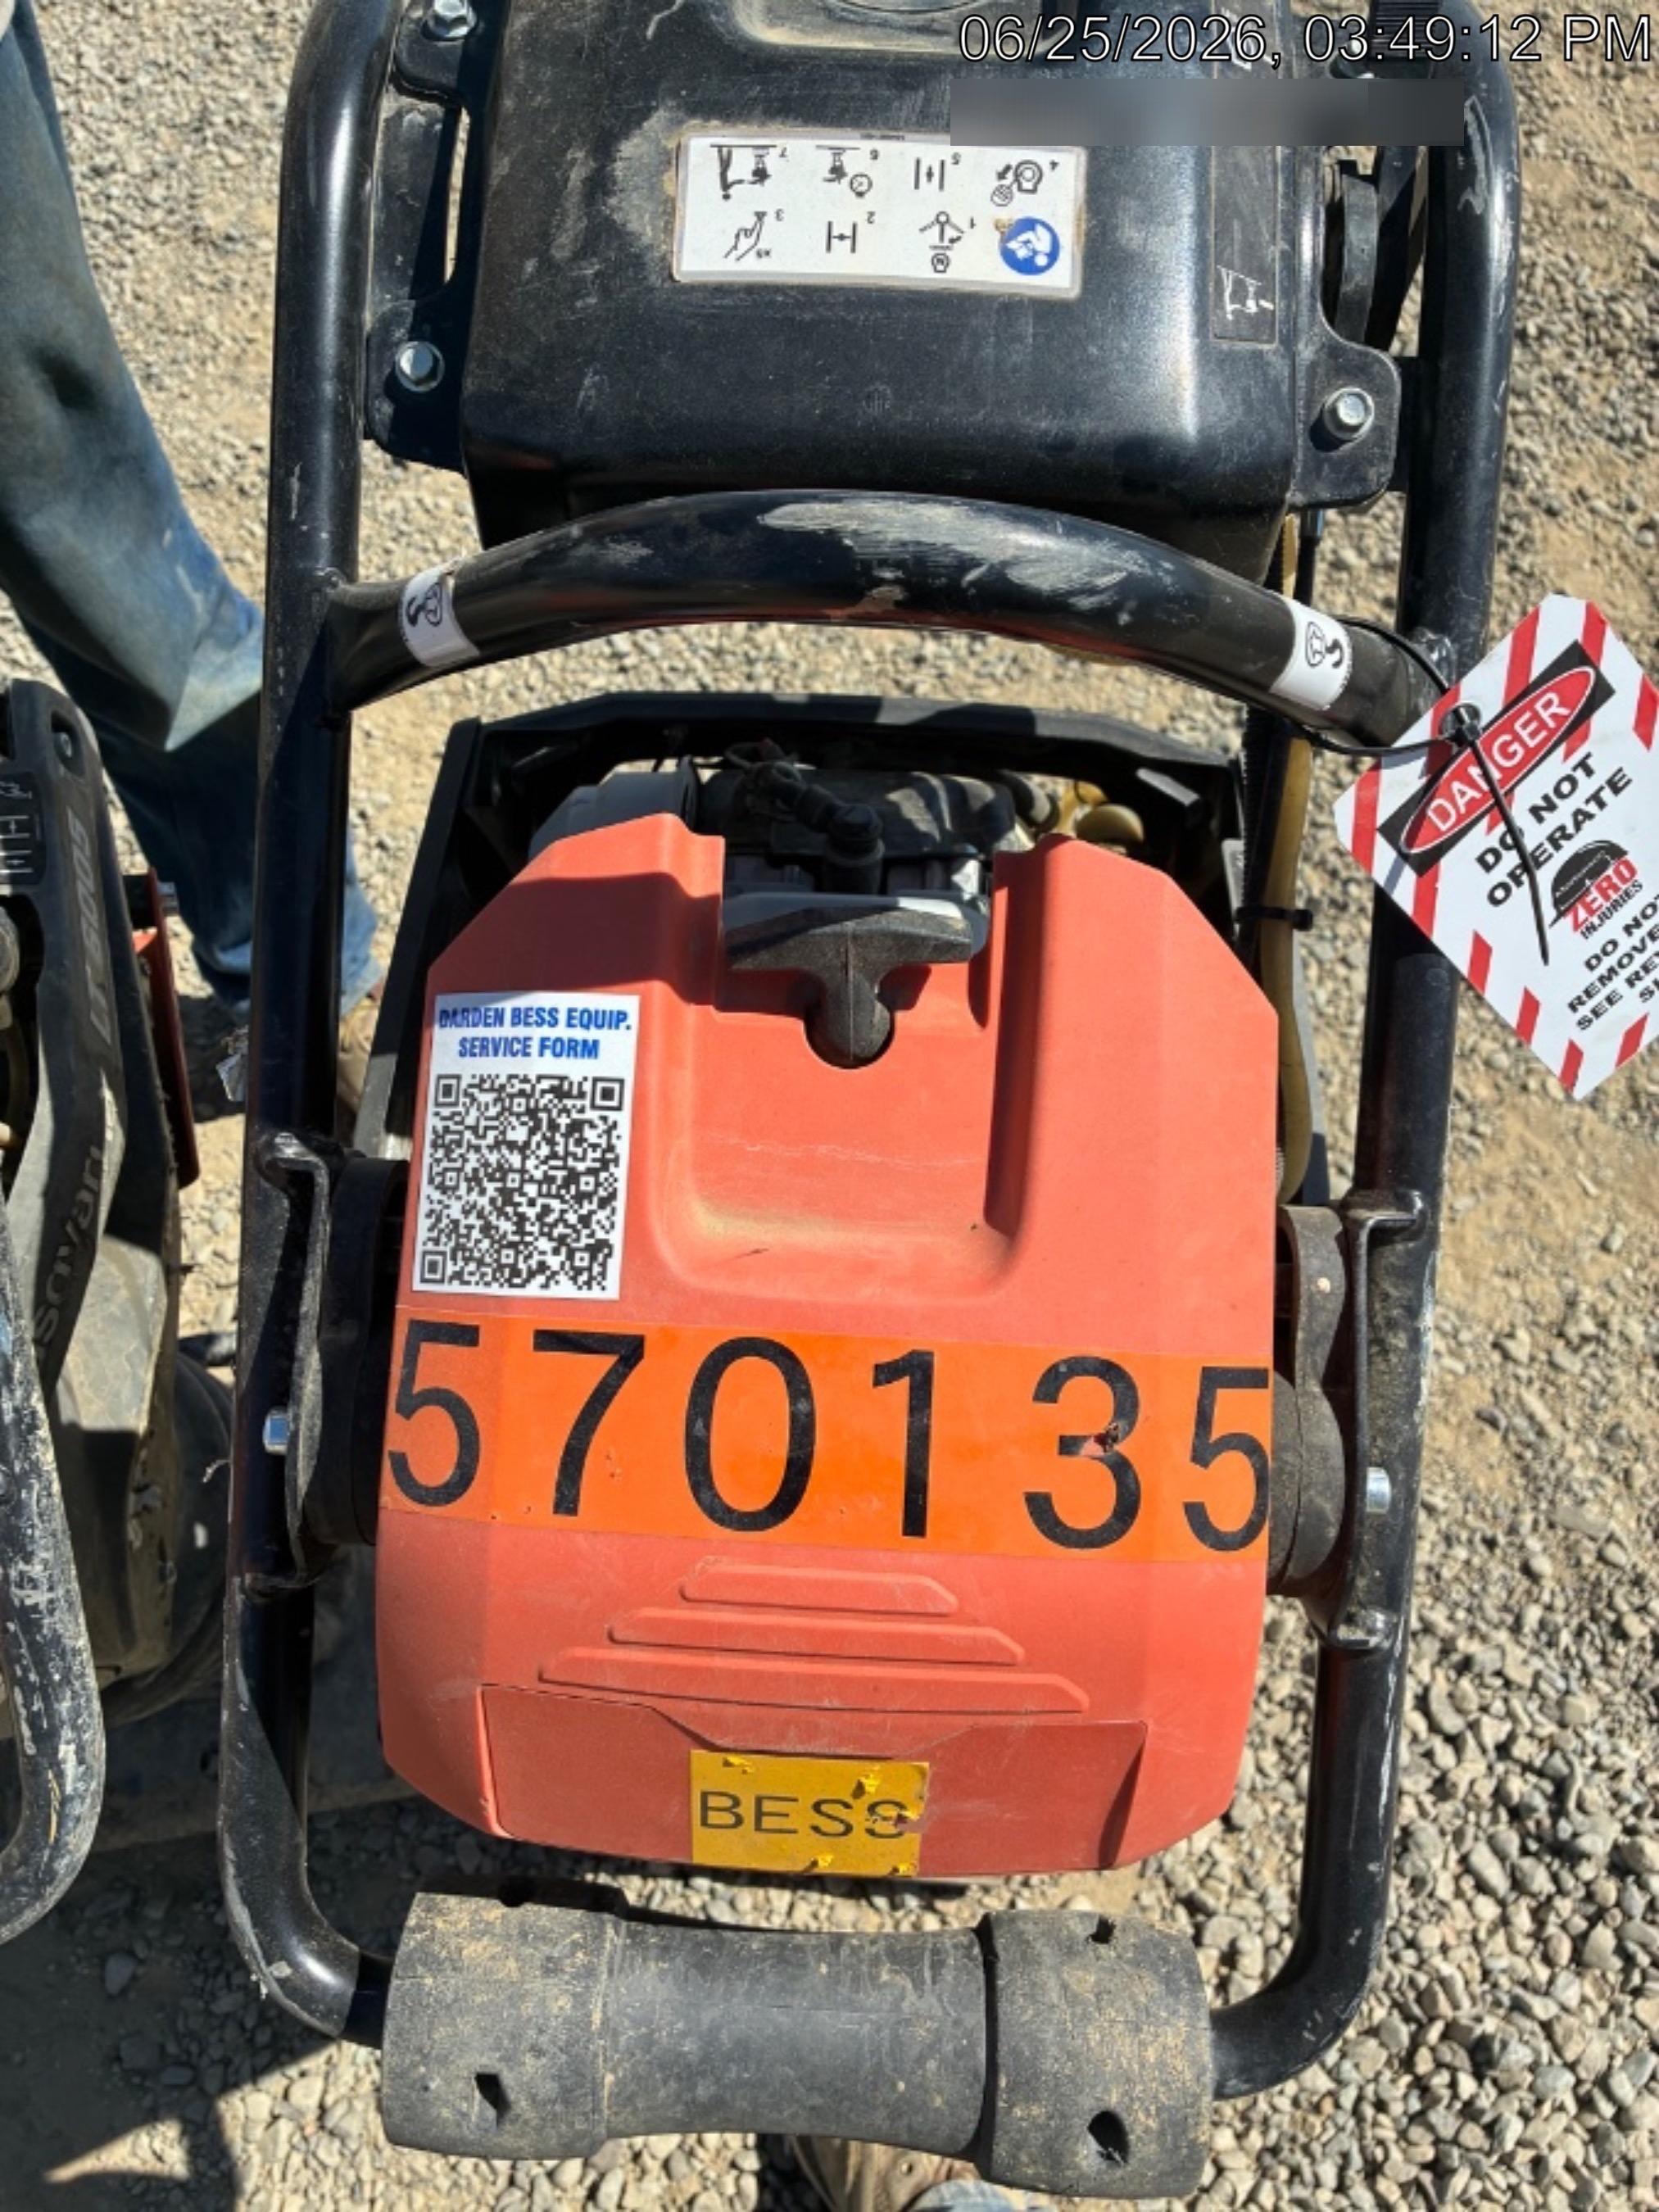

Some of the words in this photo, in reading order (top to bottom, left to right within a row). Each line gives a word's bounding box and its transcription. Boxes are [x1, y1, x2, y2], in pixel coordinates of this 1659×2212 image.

[1426, 691, 1571, 834] DANGER
[1475, 827, 1526, 873] DO
[1528, 752, 1598, 827] NOT
[1486, 767, 1634, 907] OPERATE
[1564, 857, 1638, 933] ZERO
[1580, 879, 1643, 940] INJURIES
[1584, 938, 1619, 972] DO
[1622, 894, 1659, 937] NO
[439, 1007, 505, 1029] DARDEN
[510, 1007, 559, 1028] BESS
[566, 1009, 632, 1031] EQUIP.
[459, 1036, 533, 1058] SERVICE
[538, 1038, 600, 1059] FORM
[1576, 988, 1624, 1031] SEE
[387, 1319, 1271, 1552] 570135
[700, 1791, 908, 1839] BESS
